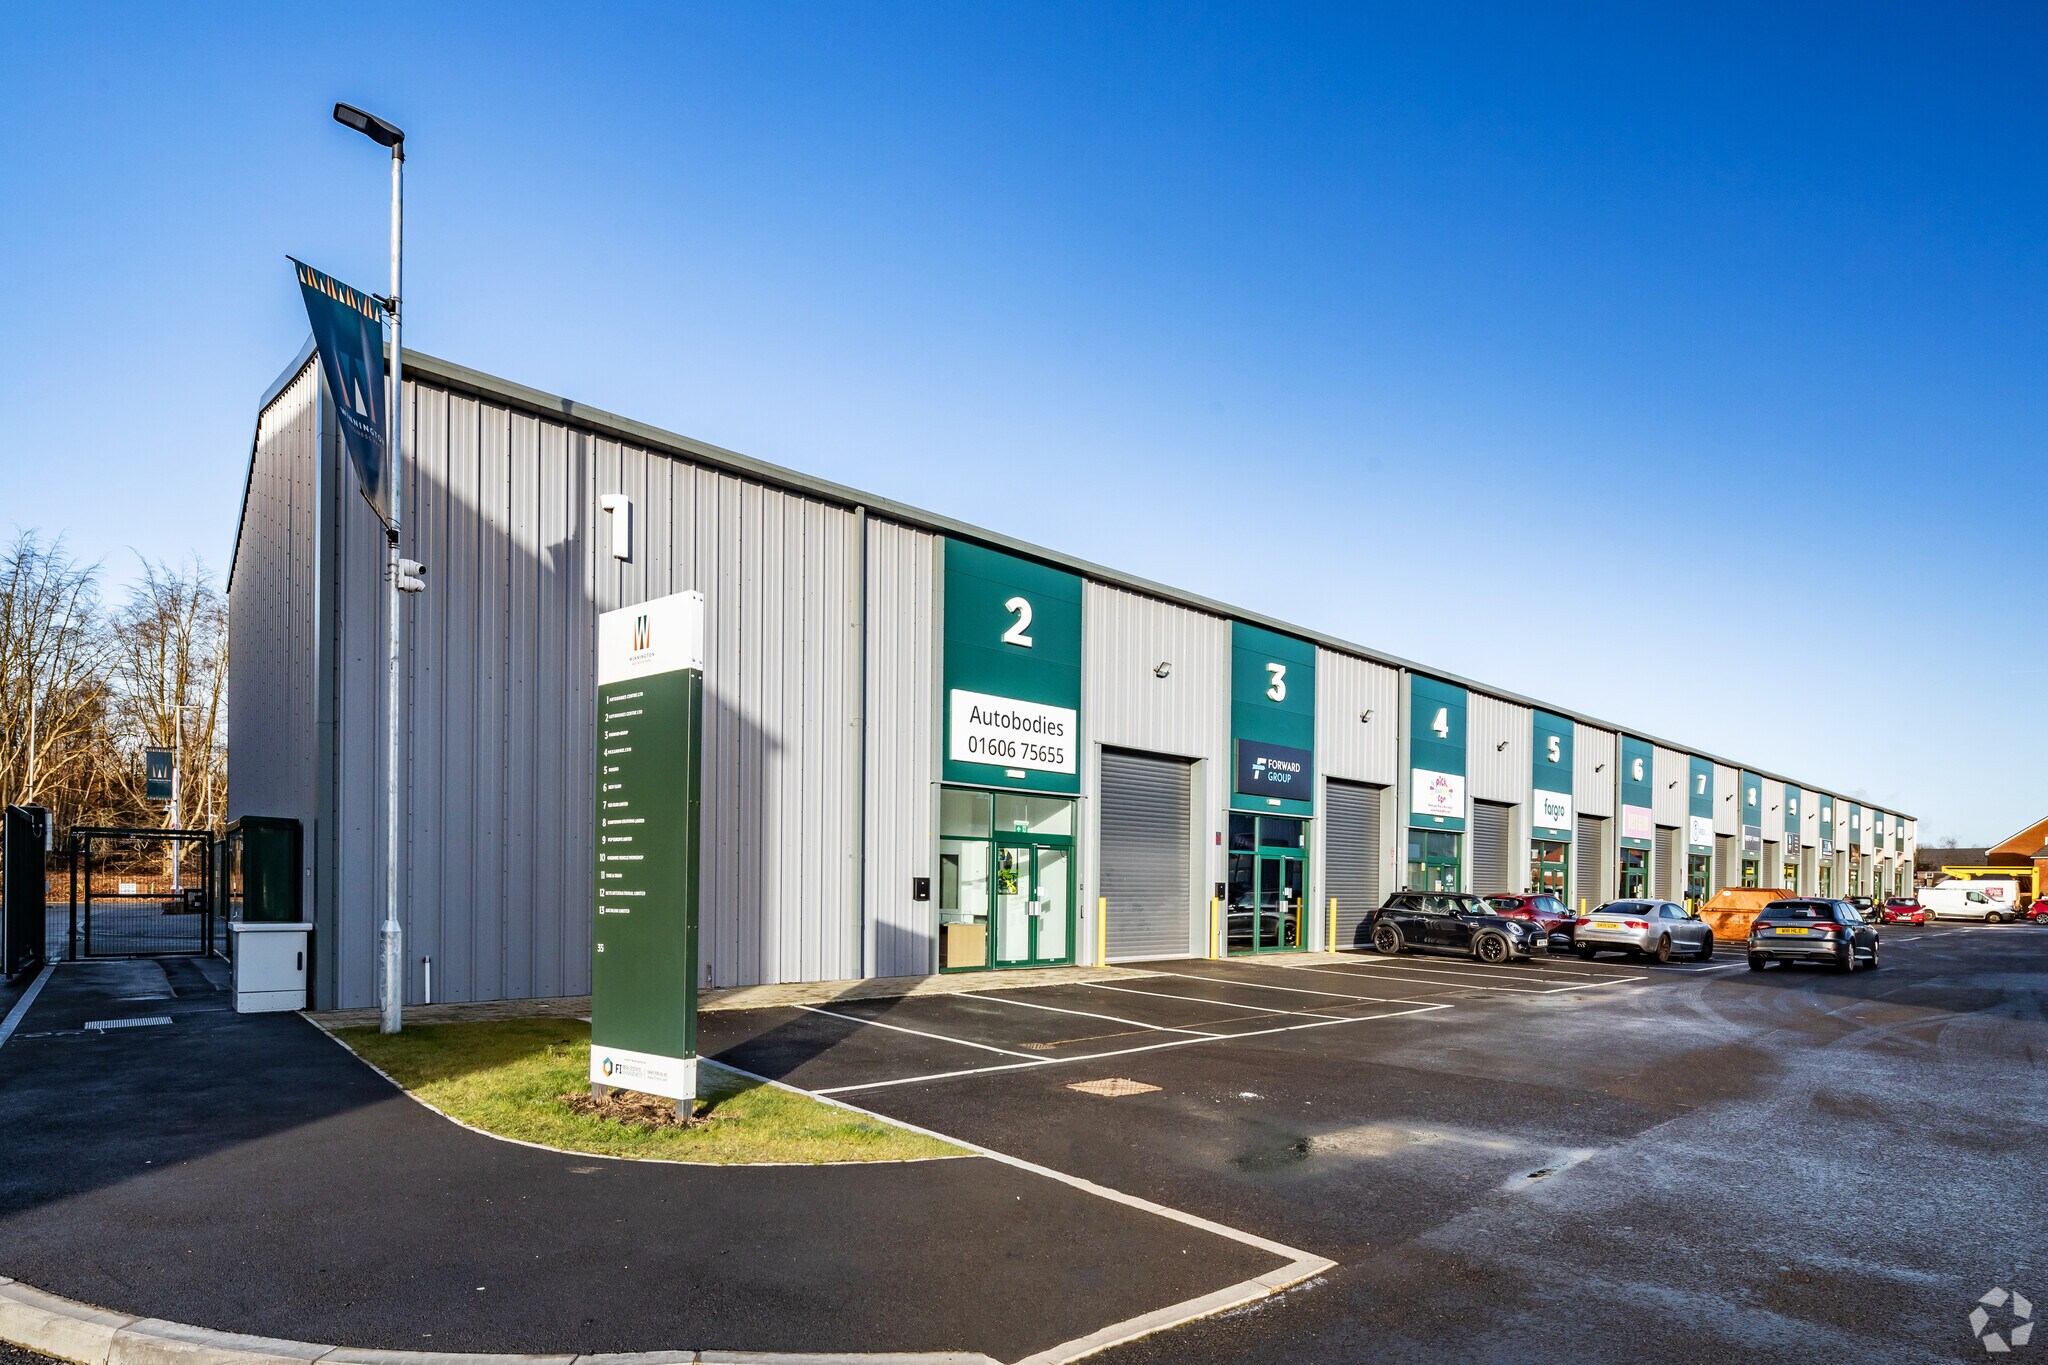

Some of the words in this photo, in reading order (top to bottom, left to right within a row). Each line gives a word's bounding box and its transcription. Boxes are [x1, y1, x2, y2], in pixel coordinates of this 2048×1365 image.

[1002, 596, 1033, 648] 2
[1266, 662, 1287, 702] 3
[604, 713, 609, 723] 2
[969, 705, 1064, 738] Autobodies
[1432, 707, 1449, 739] 4
[604, 730, 609, 740] 3
[603, 748, 608, 757] 4
[968, 735, 1016, 758] 01606
[1020, 742, 1064, 764] 75655
[1547, 736, 1561, 763] 5
[603, 765, 608, 775] 5
[1268, 758, 1301, 773] FORWARD
[1632, 758, 1644, 782] 6
[1267, 771, 1292, 784] GROUP
[1696, 774, 1707, 795] 7
[602, 783, 608, 793] 6
[602, 800, 607, 810] 7
[1544, 798, 1565, 822] fargro
[602, 818, 607, 827] 8
[601, 835, 607, 845] 9
